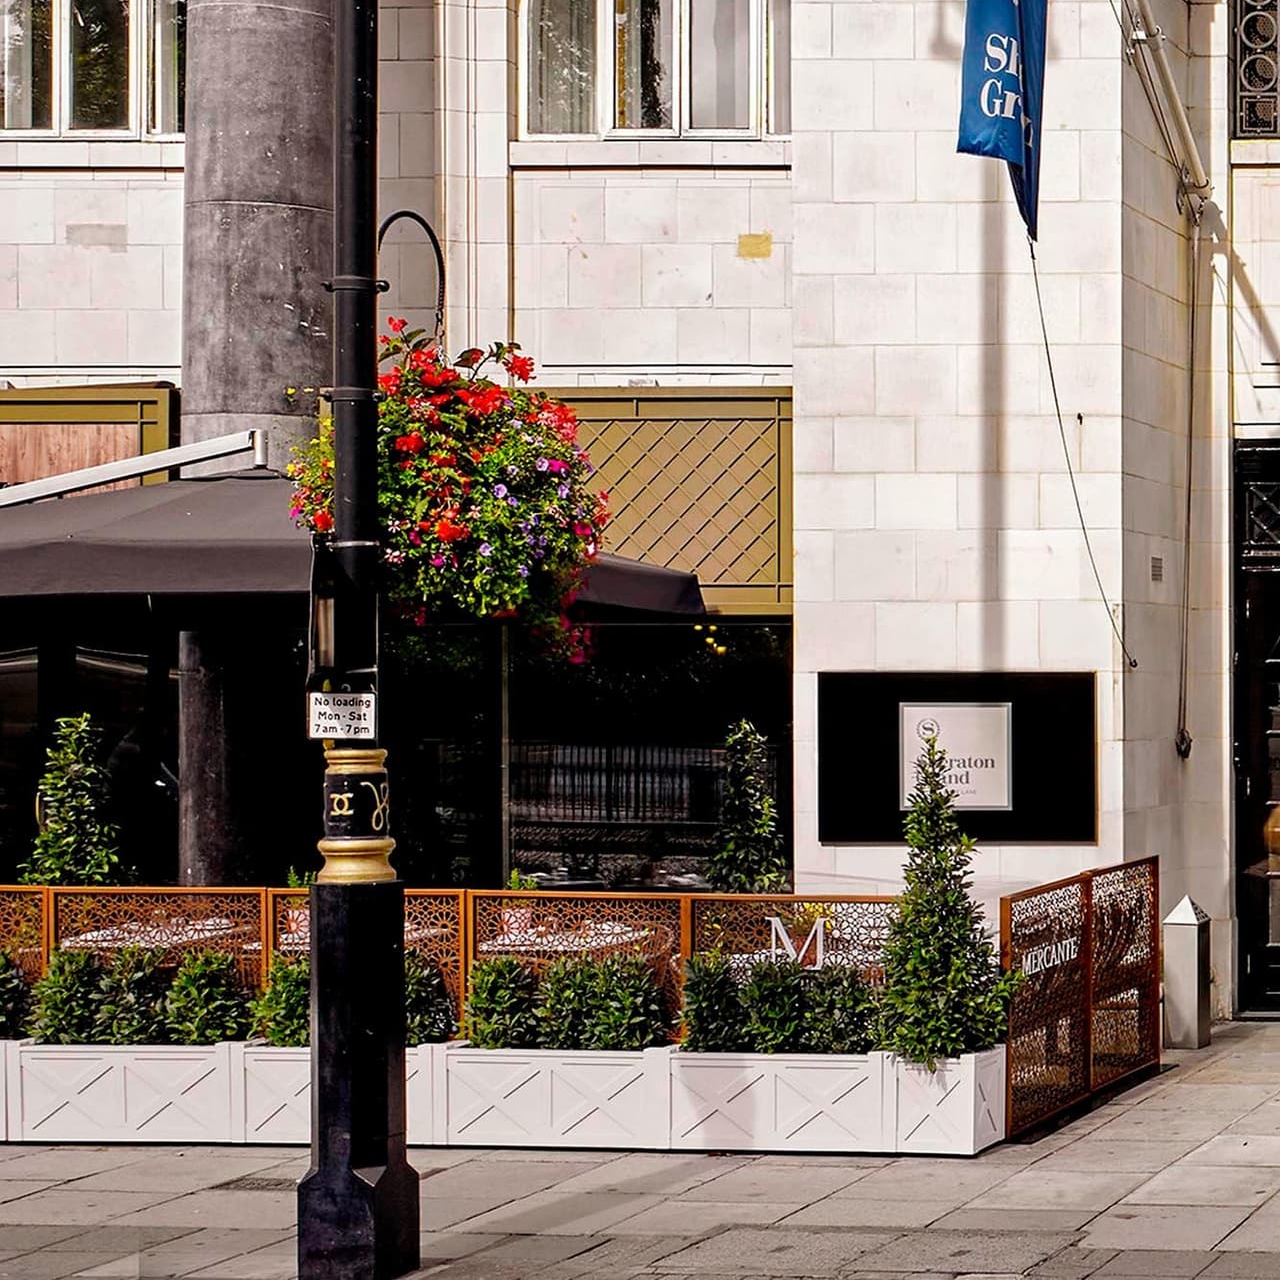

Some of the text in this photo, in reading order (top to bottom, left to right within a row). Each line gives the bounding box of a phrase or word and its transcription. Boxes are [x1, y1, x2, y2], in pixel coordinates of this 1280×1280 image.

[314, 696, 371, 708] No loading
[317, 711, 341, 721] Mon
[348, 711, 367, 721] Sat
[1021, 936, 1078, 978] MERCANTE
